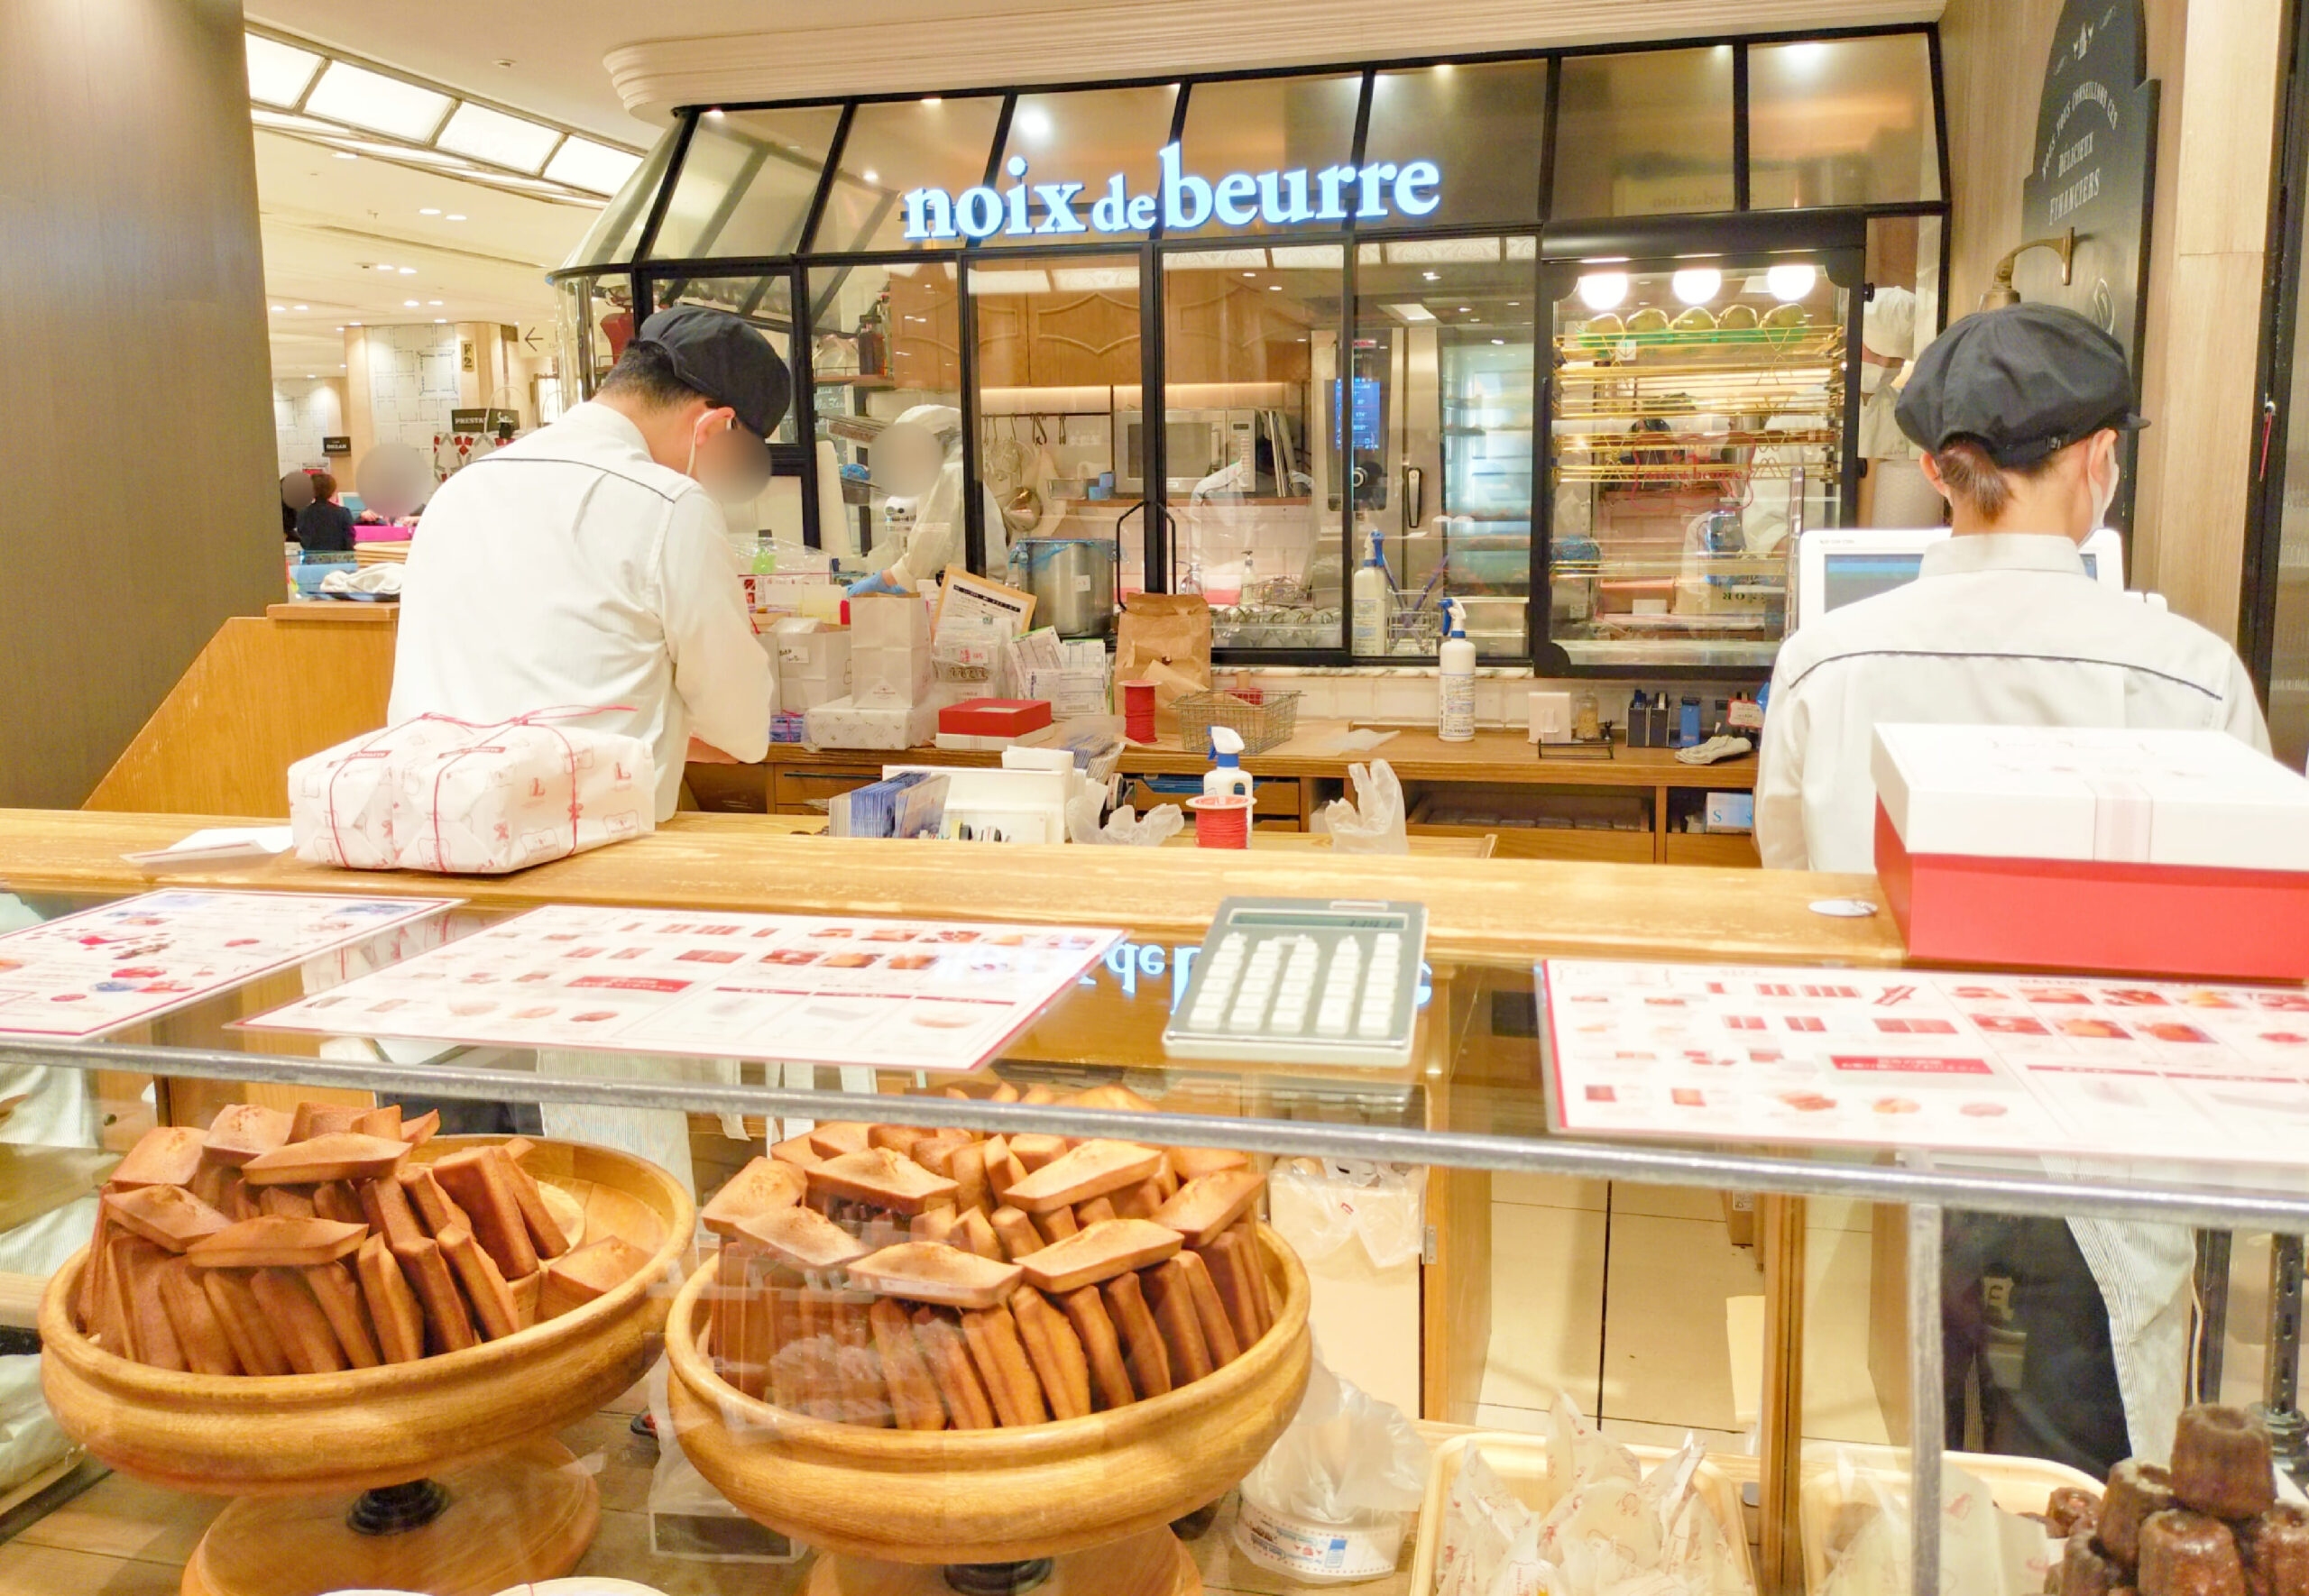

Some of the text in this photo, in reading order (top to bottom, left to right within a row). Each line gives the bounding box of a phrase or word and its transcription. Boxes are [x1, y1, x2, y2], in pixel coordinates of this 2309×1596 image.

[904, 142, 1442, 240] noix de beurre
[2049, 168, 2101, 226] FINANCIERS
